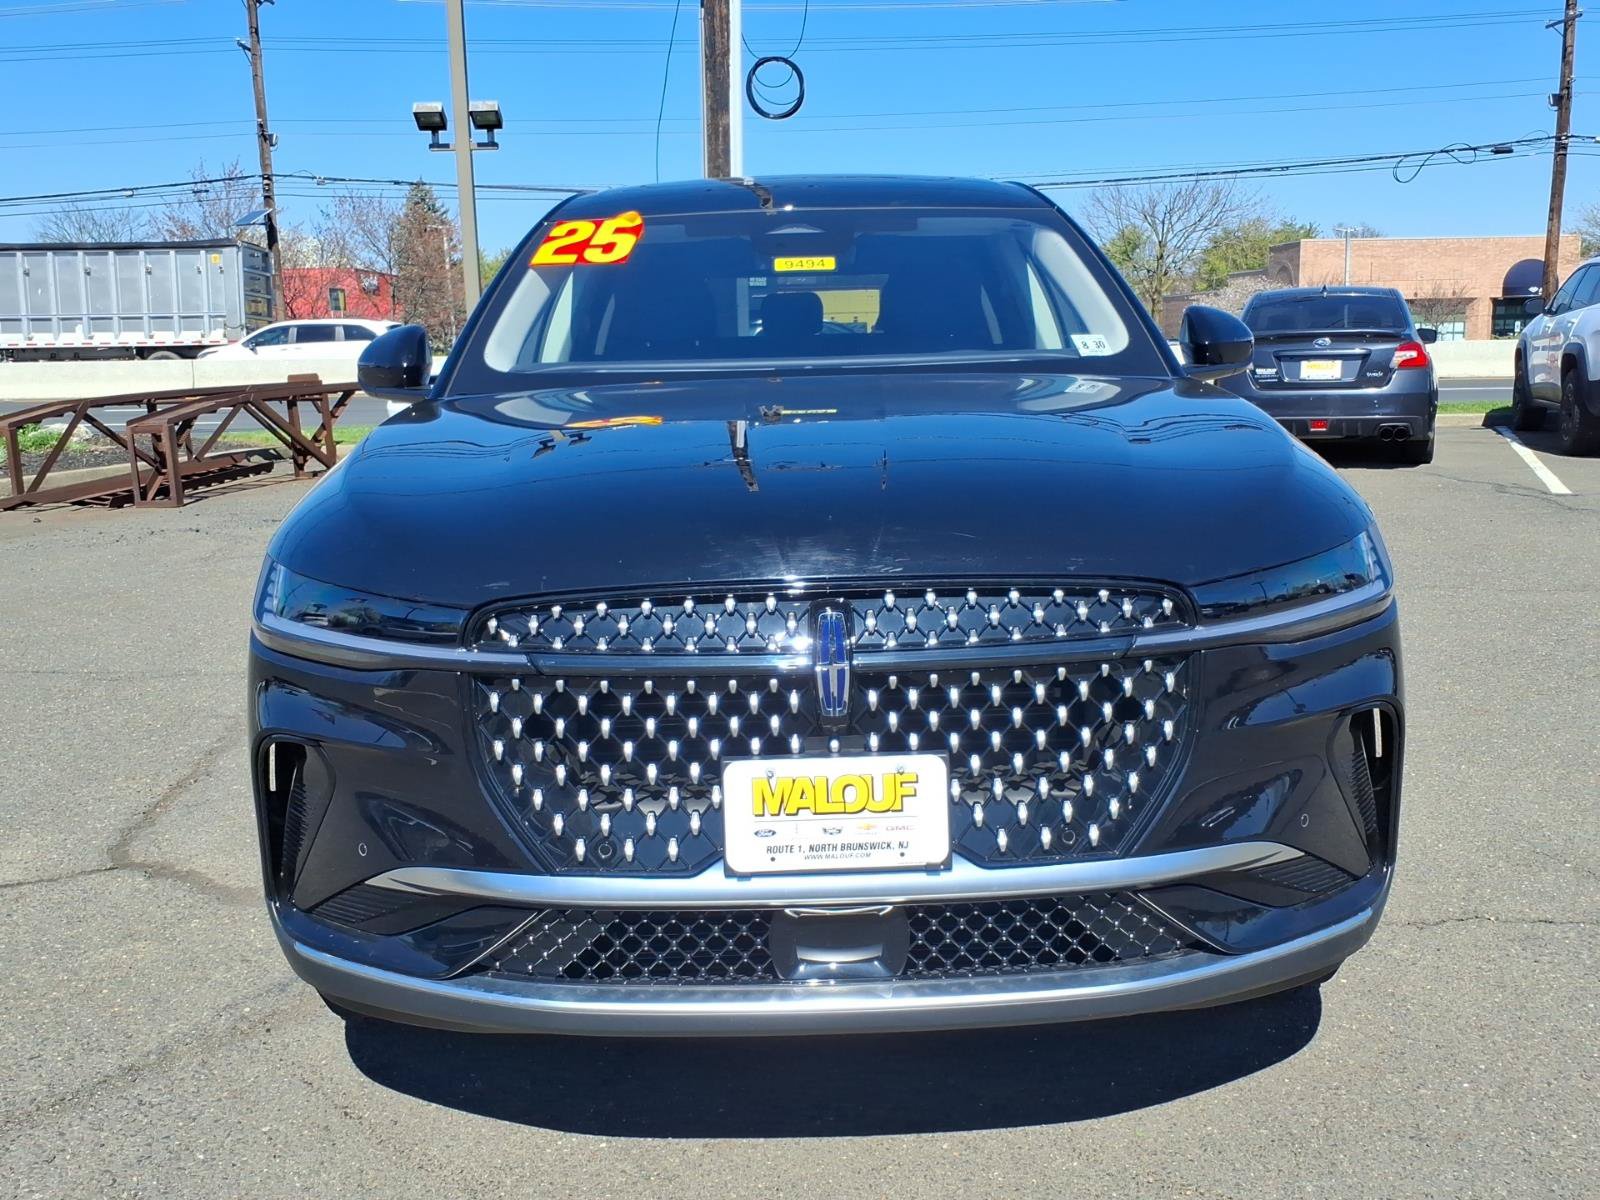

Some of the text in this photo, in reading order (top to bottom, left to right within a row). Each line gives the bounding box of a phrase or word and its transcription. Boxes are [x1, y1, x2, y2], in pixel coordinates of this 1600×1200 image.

[530, 210, 643, 265] 25
[784, 259, 826, 269] 9494
[752, 772, 918, 817] MALOUF
[766, 845, 794, 854] ROUTE
[809, 843, 838, 853] NORTH
[840, 841, 895, 852] BRUNSWICK,
[898, 841, 909, 849] NJ
